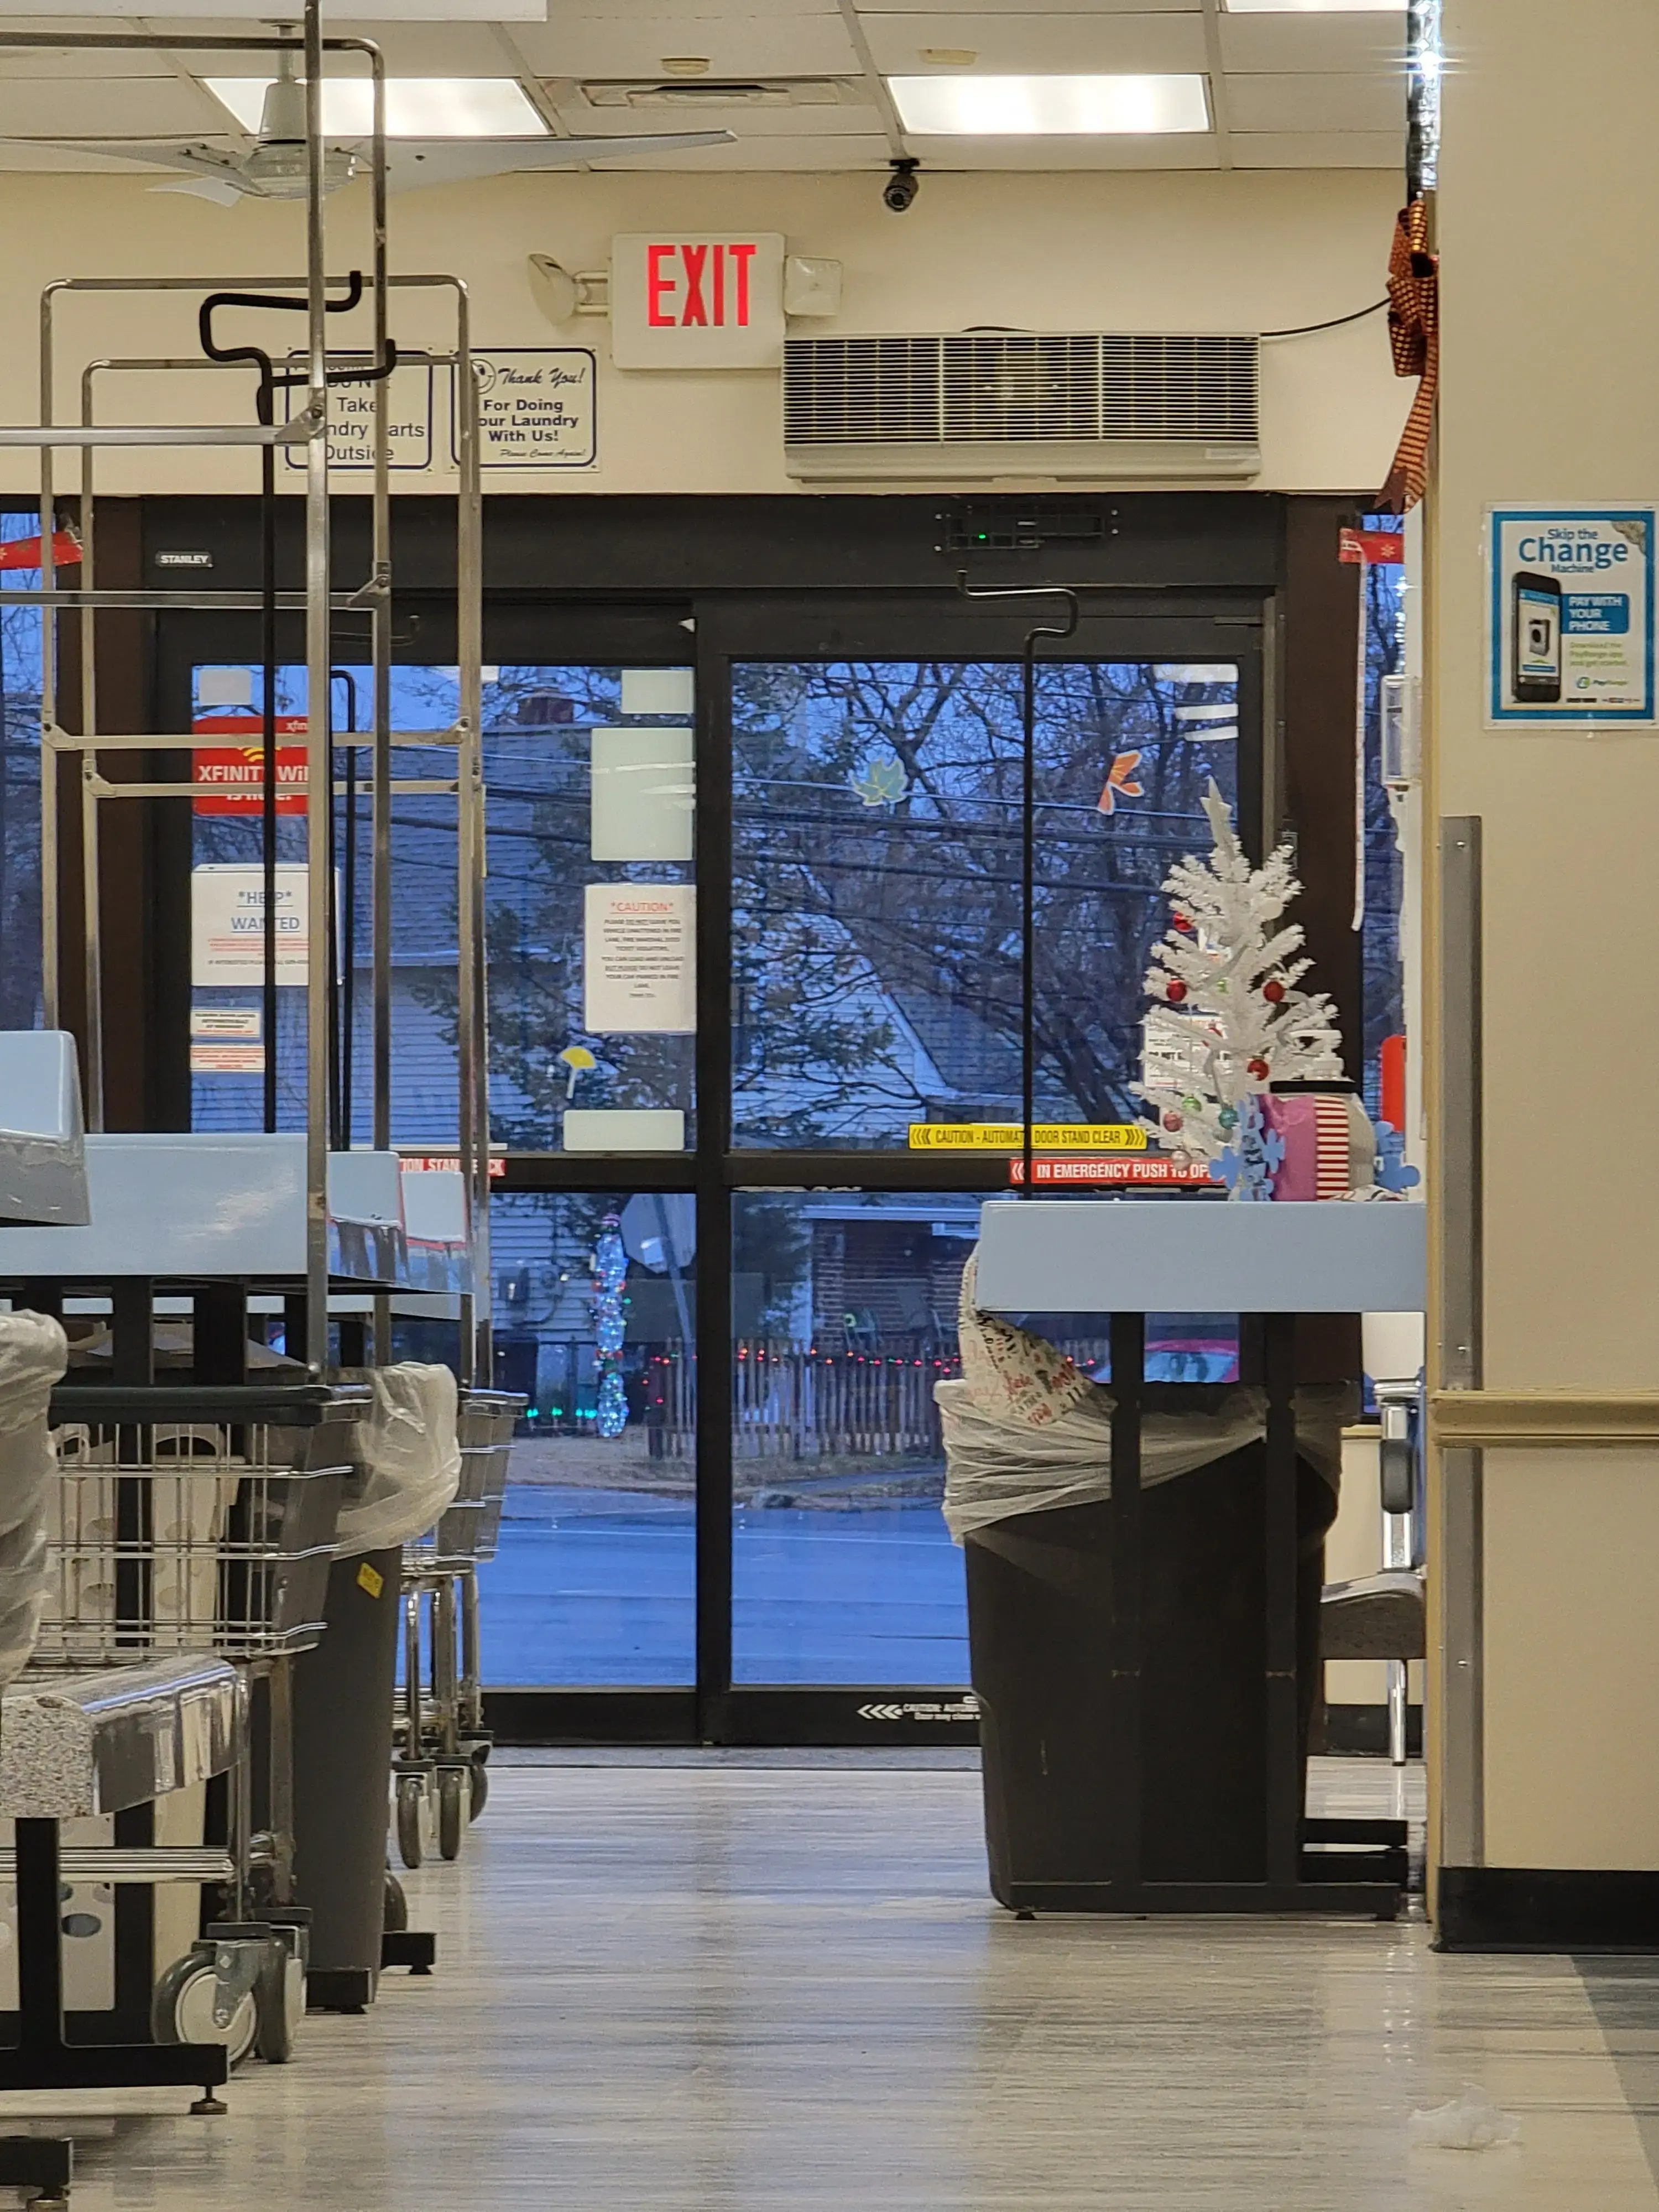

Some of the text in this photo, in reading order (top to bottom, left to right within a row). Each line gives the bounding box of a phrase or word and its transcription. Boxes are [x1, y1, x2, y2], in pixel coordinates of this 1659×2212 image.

[648, 244, 757, 326] EXIT
[498, 367, 586, 389] Thank You!
[336, 397, 377, 412] Take
[484, 398, 563, 413] For Doing
[478, 415, 579, 429] our Laundry
[327, 421, 425, 440] ndry arts
[488, 430, 559, 441] With Us!
[326, 445, 394, 460] Outsie
[1548, 528, 1598, 541] Skip the
[161, 555, 208, 564] STANLEY
[1519, 536, 1628, 569] Change
[1551, 564, 1594, 573] Machine
[1569, 596, 1622, 606] PAY WITH
[1569, 608, 1603, 618] YOUR
[1569, 621, 1610, 631] PHONE
[286, 720, 308, 732] xfin
[199, 765, 309, 781] XFINIT Wi
[239, 891, 292, 904] HEP
[936, 1130, 973, 1143] CAUTION
[982, 1130, 1025, 1143] AUTOMAT
[1035, 1130, 1058, 1144] DOOR
[1062, 1130, 1089, 1144] STAND
[1093, 1130, 1120, 1144] CLEAR
[428, 1159, 461, 1172] STAN
[1037, 1164, 1050, 1178] IN
[1053, 1164, 1129, 1178] EMERGENCY
[1134, 1164, 1167, 1178] PUSH
[1190, 1164, 1210, 1178] OP
